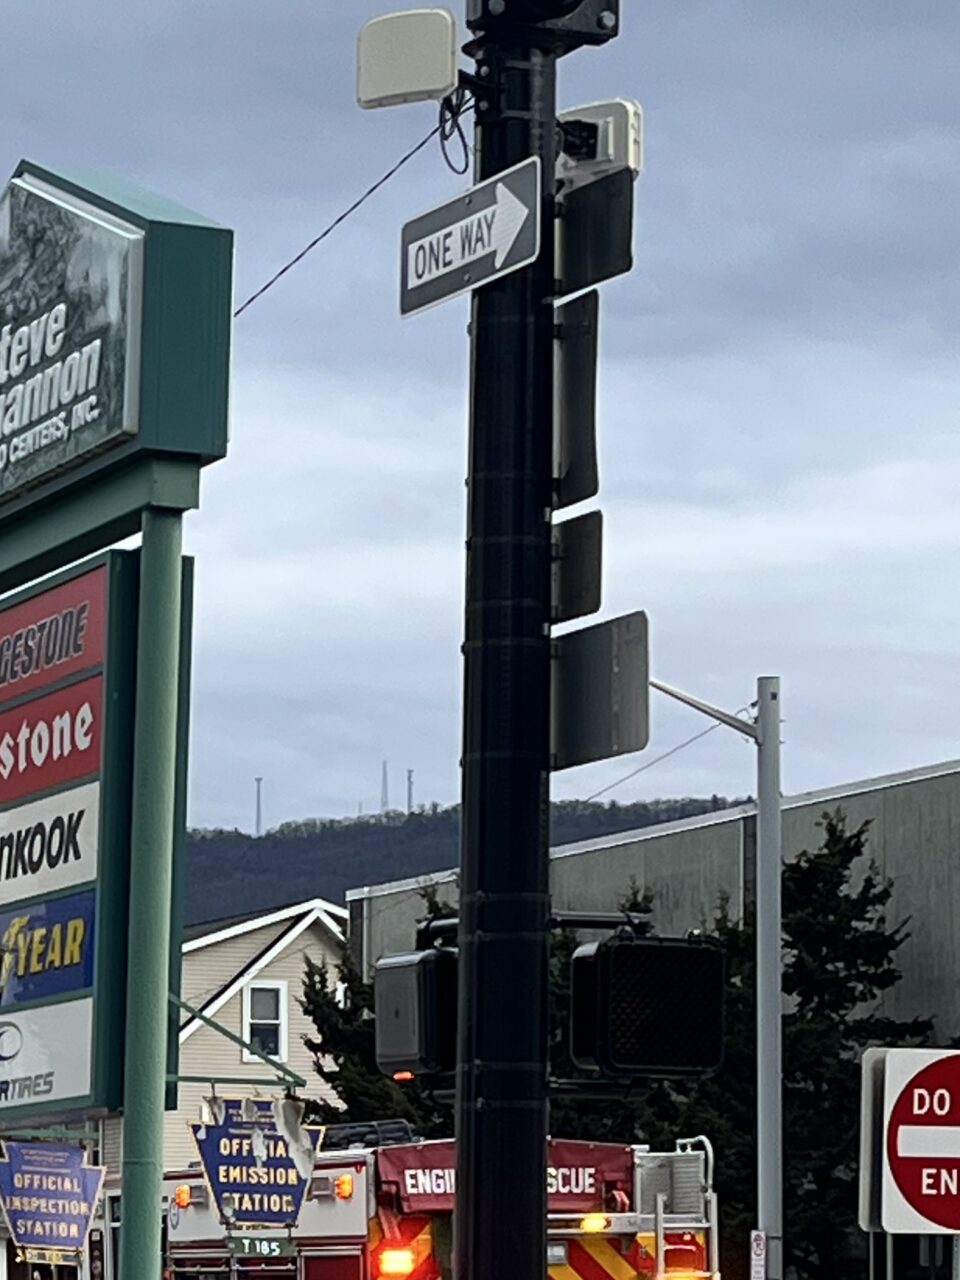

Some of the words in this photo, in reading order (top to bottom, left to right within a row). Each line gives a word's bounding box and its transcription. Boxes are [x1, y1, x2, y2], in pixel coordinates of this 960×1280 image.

[414, 230, 453, 280] ONE
[459, 210, 497, 260] WAY
[913, 1088, 951, 1115] DO
[220, 1138, 287, 1158] OFFIA
[14, 1173, 81, 1193] OFFICIAL
[219, 1165, 298, 1185] EMISSION
[404, 1168, 456, 1194] ENGI
[546, 1167, 596, 1194] SCUE
[6, 1196, 90, 1216] INSPECTION
[222, 1192, 295, 1212] TATION
[17, 1219, 79, 1238] STATION
